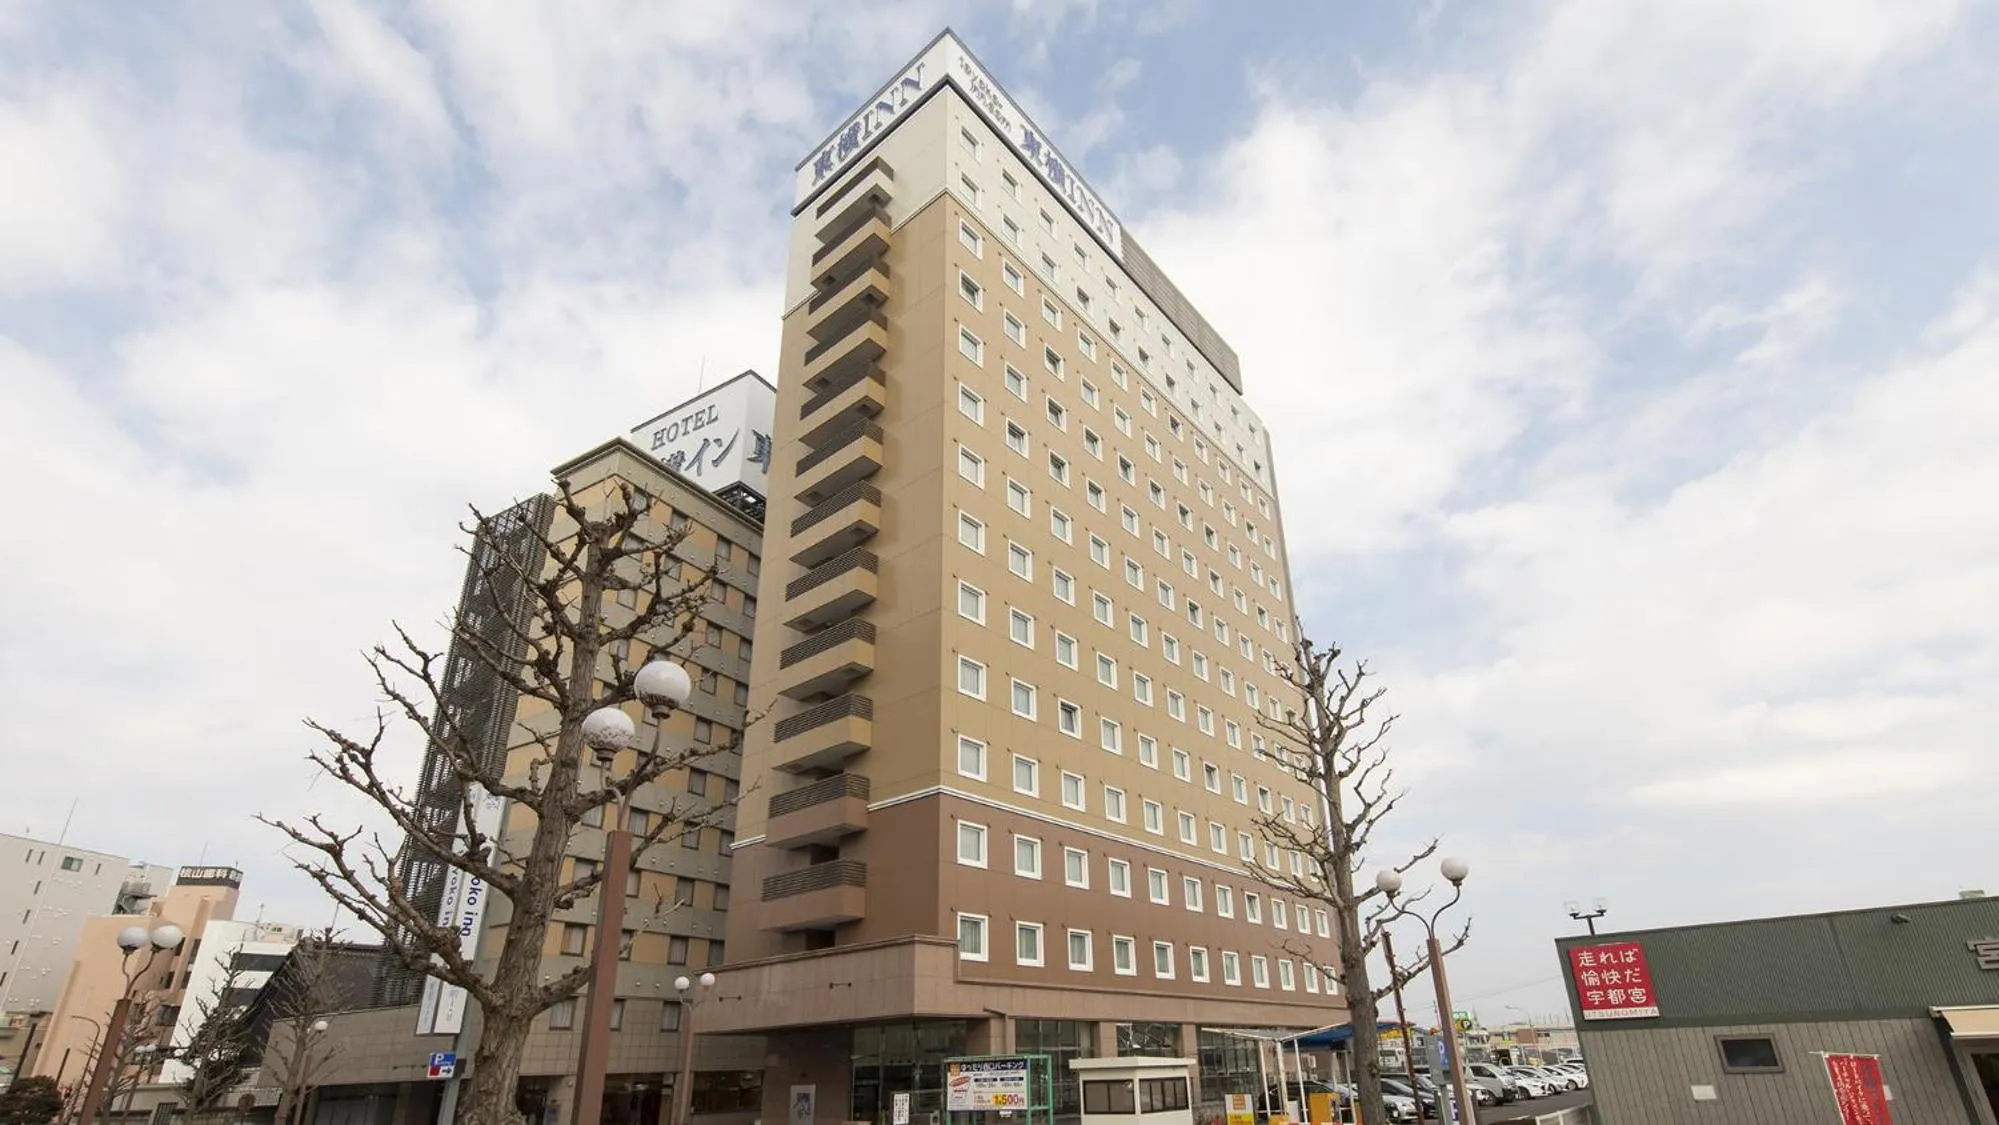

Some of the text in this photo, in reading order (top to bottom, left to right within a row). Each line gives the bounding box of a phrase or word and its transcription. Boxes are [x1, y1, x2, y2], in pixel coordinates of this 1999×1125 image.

[650, 404, 719, 451] HOTEL
[1578, 948, 1639, 967] 走れば
[1581, 967, 1642, 987] 愉快だ
[1586, 987, 1647, 1005] 宇都宮
[435, 1053, 444, 1065] P
